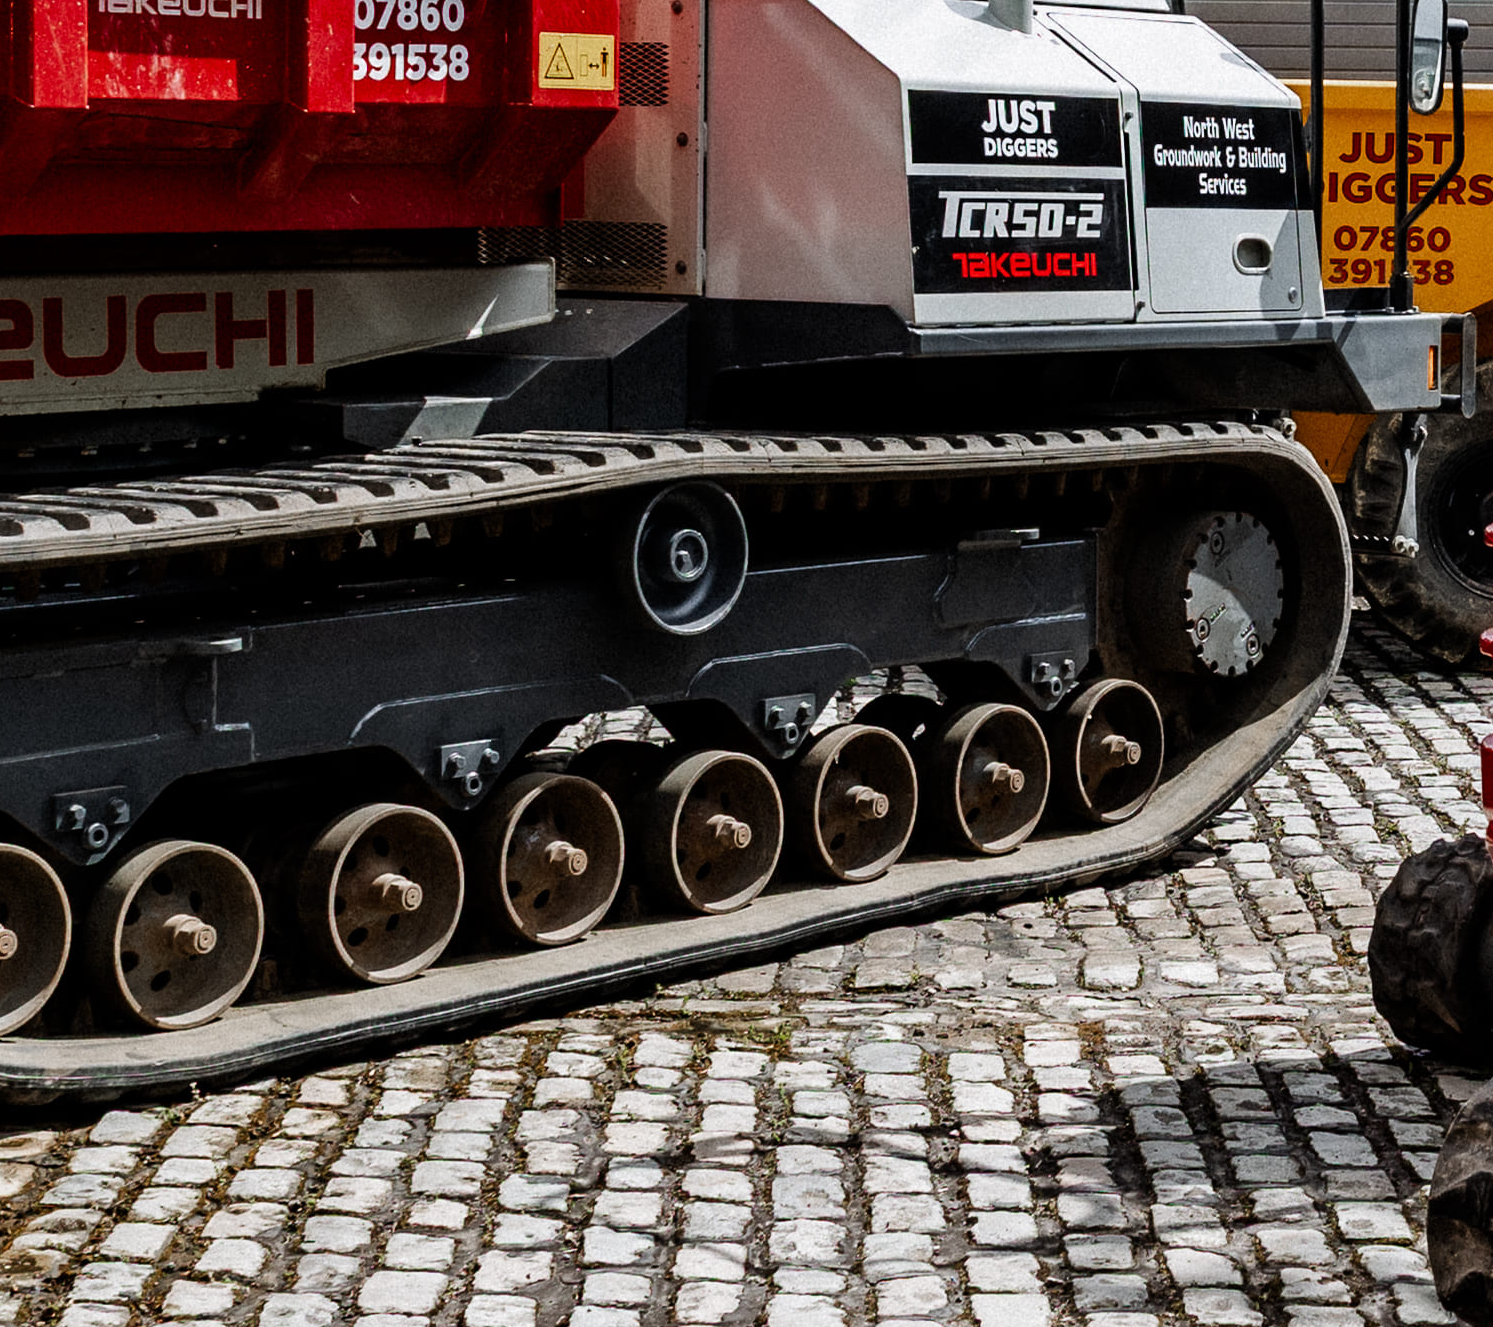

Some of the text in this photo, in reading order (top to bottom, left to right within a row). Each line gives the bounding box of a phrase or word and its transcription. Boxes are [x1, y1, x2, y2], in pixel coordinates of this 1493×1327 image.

[353, 42, 470, 81] 391538
[981, 99, 1056, 134] JUST
[1183, 116, 1255, 140] North West
[983, 137, 1058, 158] DIGGERS
[1154, 144, 1287, 173] Groundwork & Building
[1339, 132, 1452, 164] JUST
[1199, 173, 1247, 195] Services
[1322, 172, 1493, 205] IGGERS
[938, 190, 1105, 238] TCR50-2
[1334, 225, 1451, 252] 07860
[1328, 258, 1454, 285] 39138
